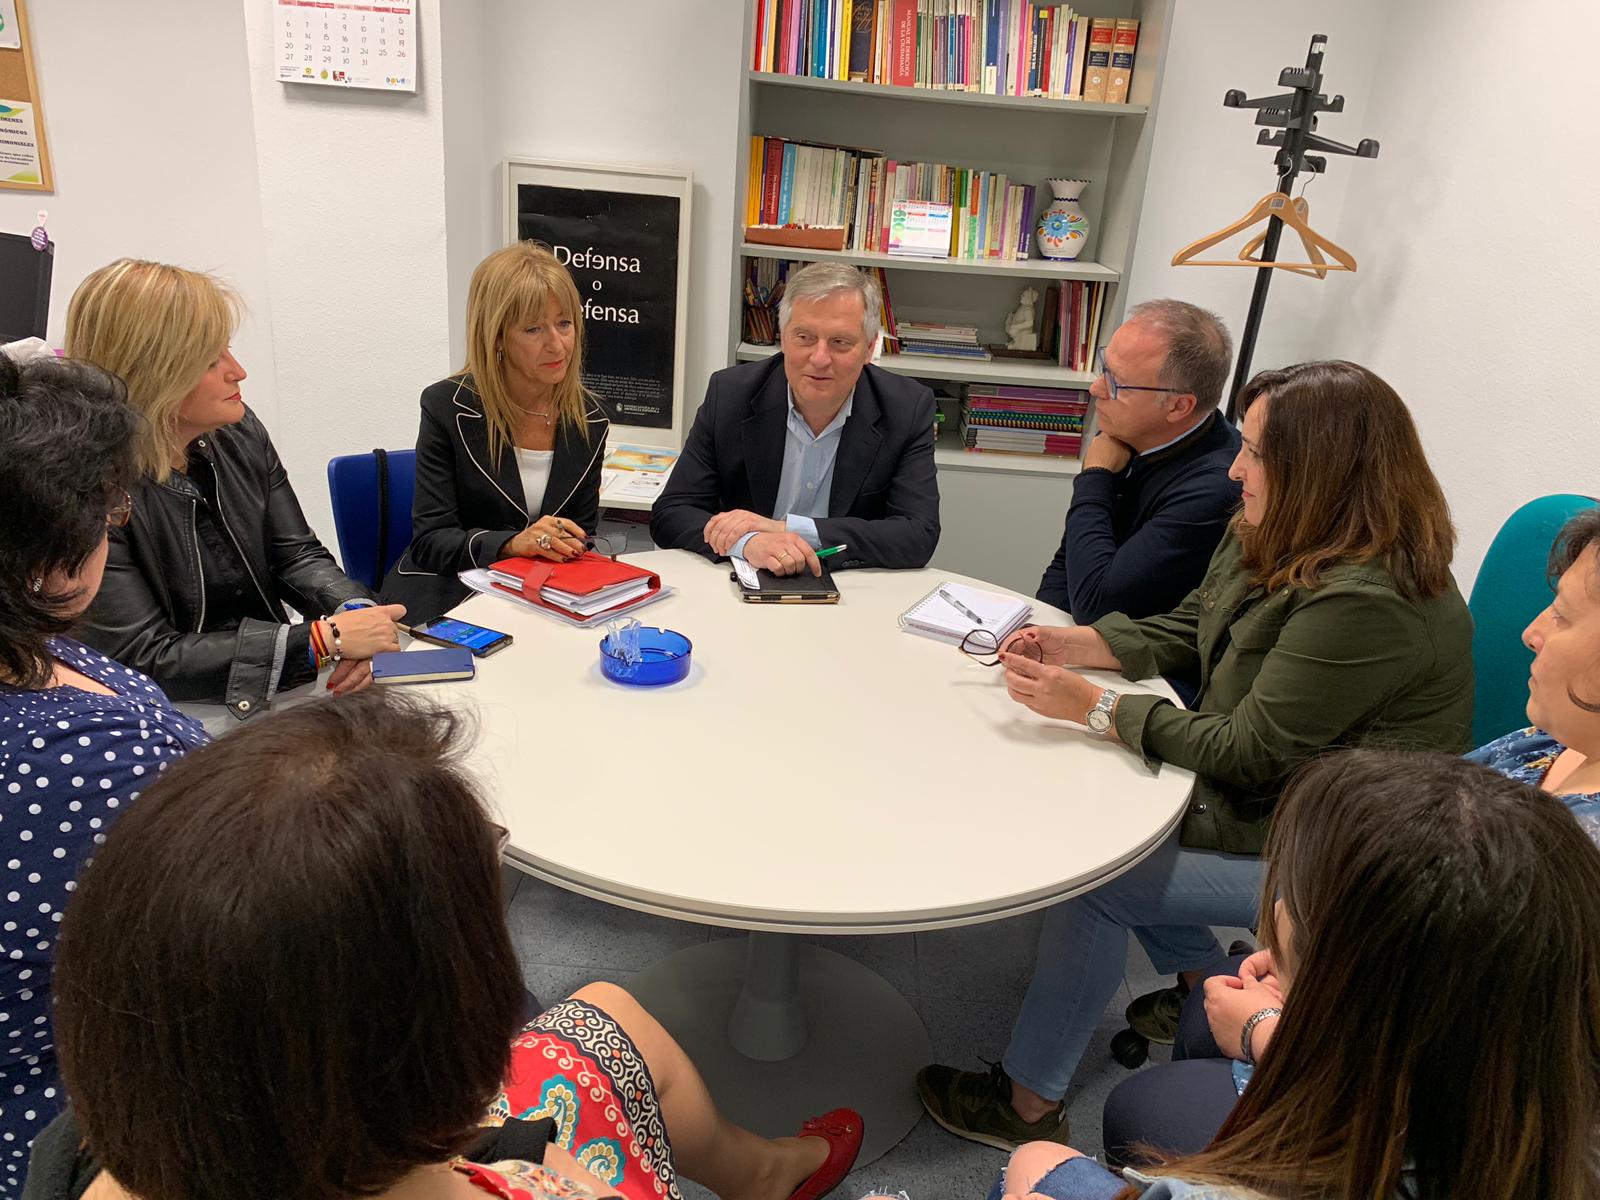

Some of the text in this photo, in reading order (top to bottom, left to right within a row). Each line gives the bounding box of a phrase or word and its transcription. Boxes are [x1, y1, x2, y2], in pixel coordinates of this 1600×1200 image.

[0, 139, 34, 148] IMONIALES
[592, 280, 602, 290] o
[580, 298, 640, 324] fensa
